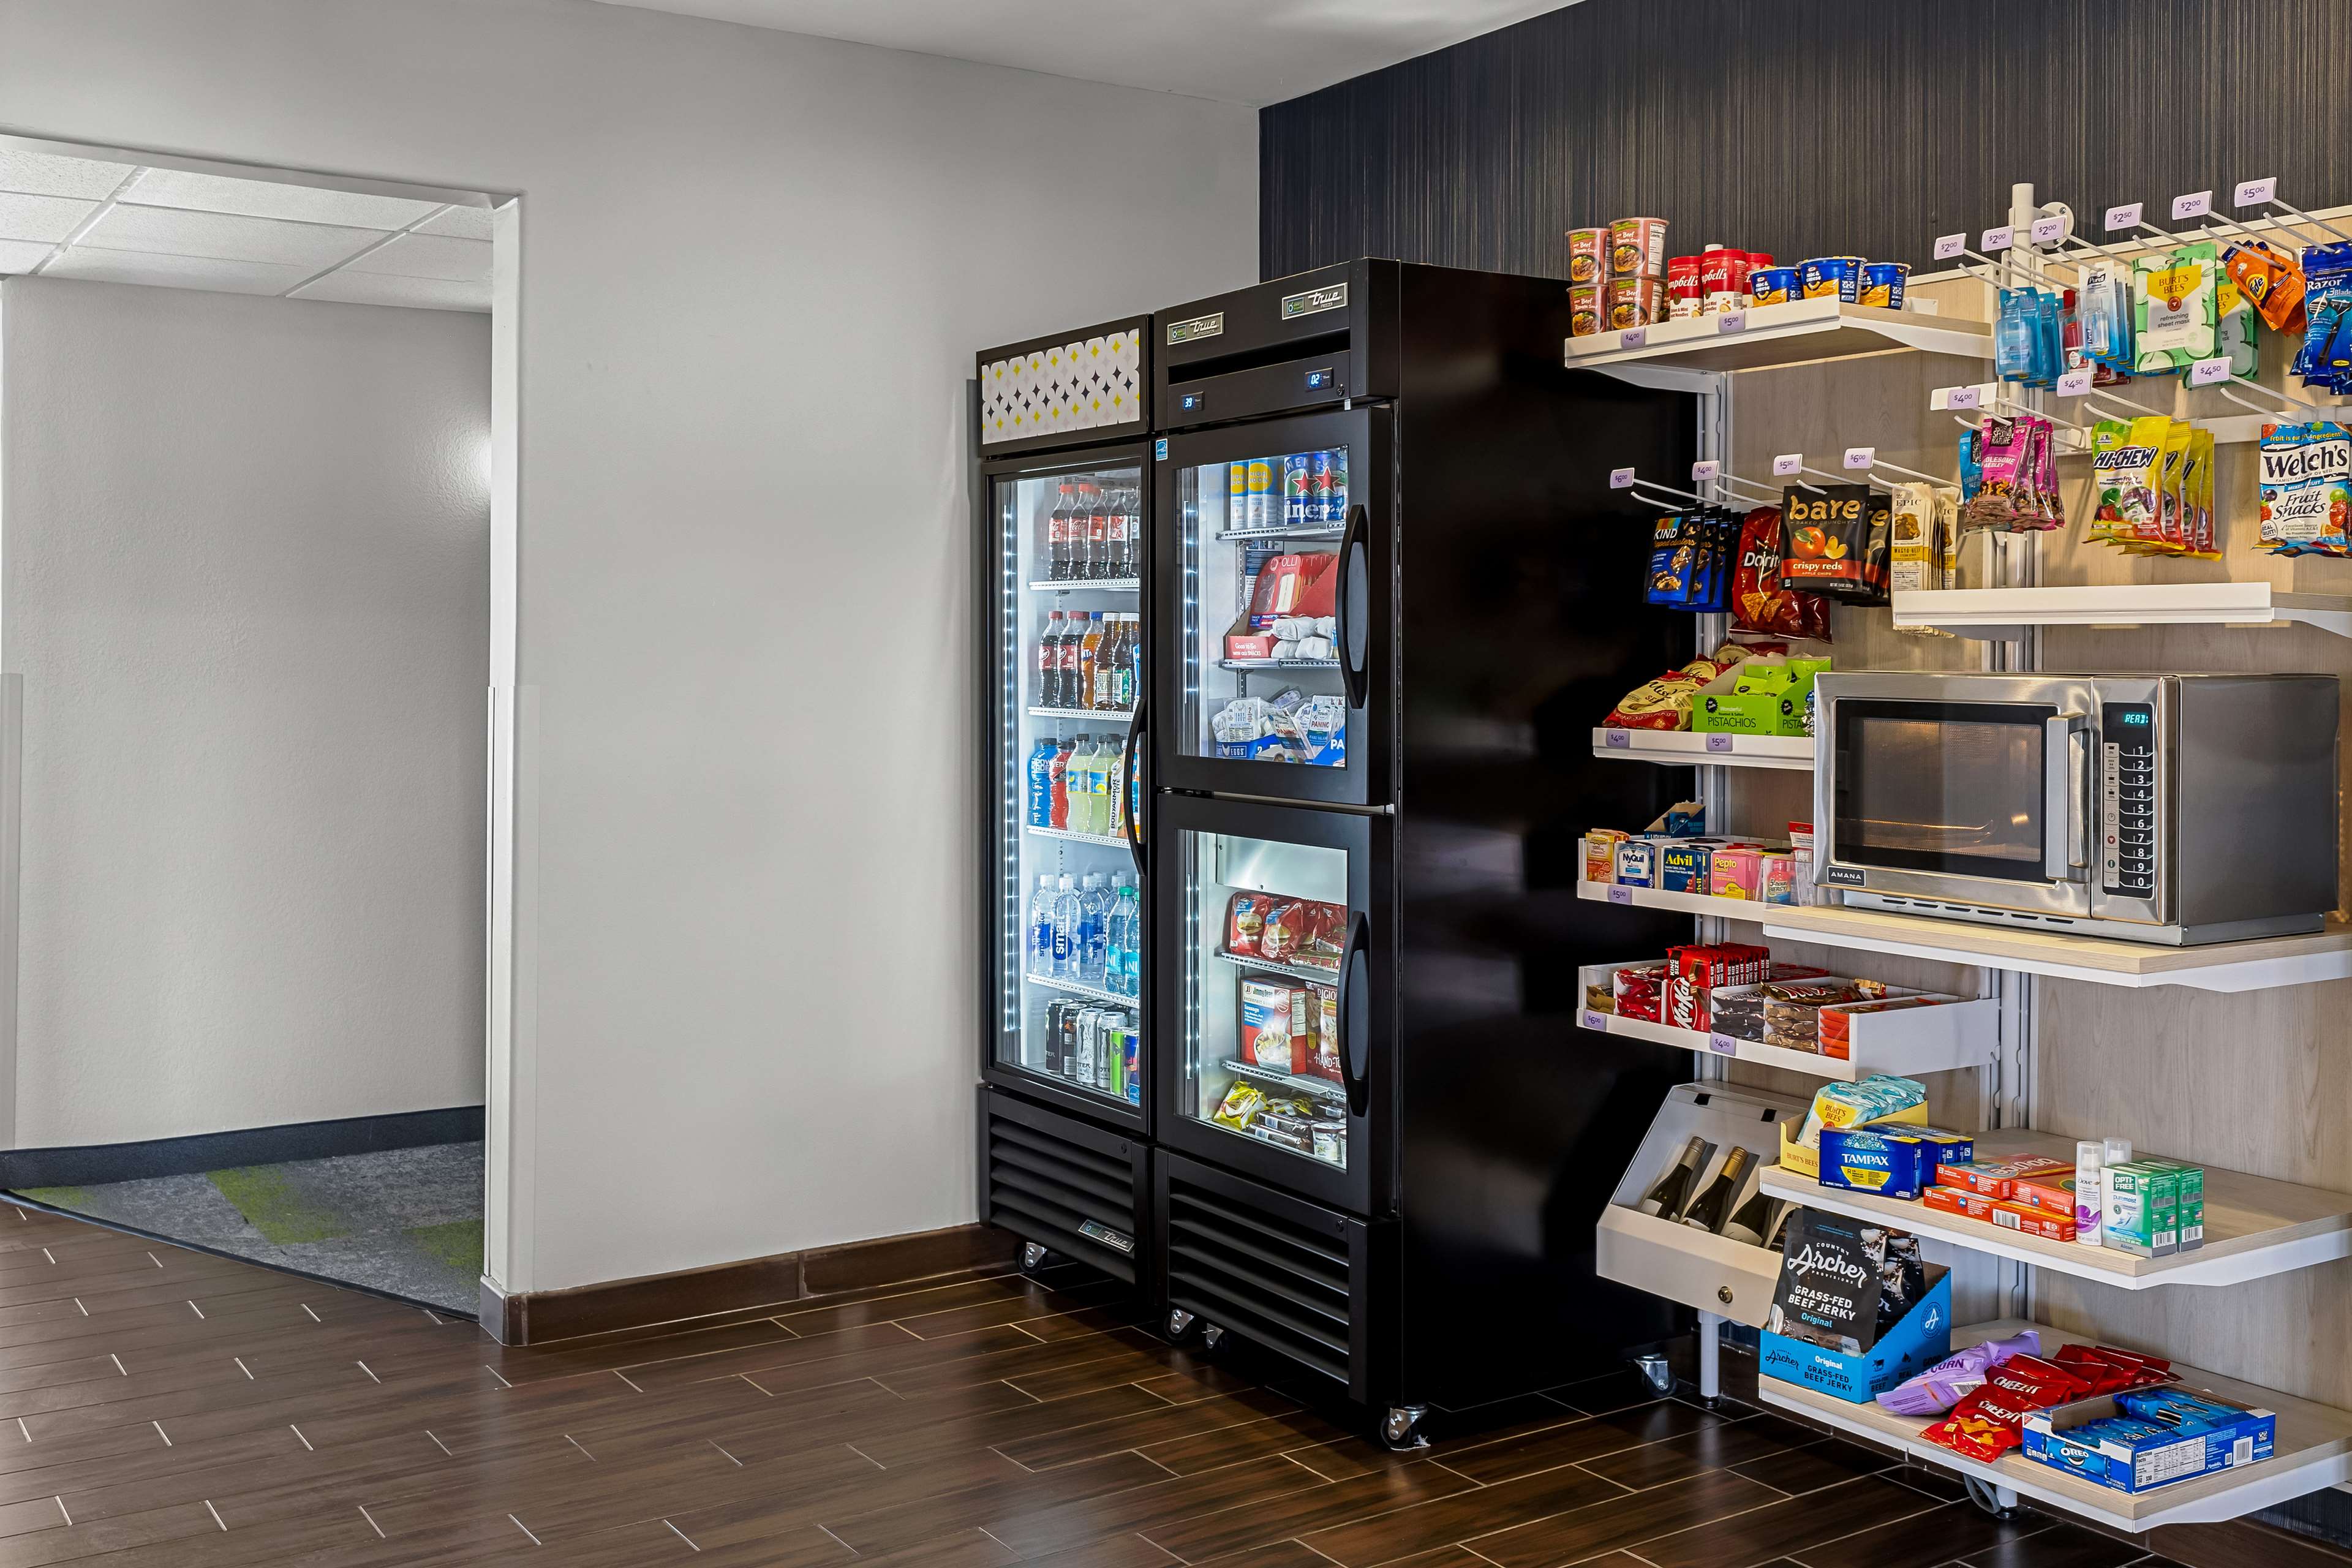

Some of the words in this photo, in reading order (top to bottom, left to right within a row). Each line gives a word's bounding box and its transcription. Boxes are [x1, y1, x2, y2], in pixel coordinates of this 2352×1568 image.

[2159, 274, 2189, 287] BURT'S
[2307, 279, 2342, 292] Razor
[2163, 284, 2185, 294] BEES
[2249, 276, 2266, 299] Tide
[1308, 292, 1343, 306] True
[2160, 312, 2189, 322] refreshing
[1189, 320, 1220, 333] True
[1311, 374, 1320, 385] 02
[1185, 397, 1193, 407] 39
[2094, 447, 2158, 470] HI-CHEW
[2263, 445, 2348, 478] Welch's
[2285, 490, 2321, 507] Fruit
[1790, 494, 1861, 520] bare
[2274, 502, 2326, 519] Snacks
[1654, 529, 1678, 540] KIND
[1282, 557, 1298, 567] OLLI
[1793, 562, 1820, 571] crispy
[1822, 562, 1842, 570] reds
[1708, 717, 1757, 728] PISTACHIOS
[1231, 747, 1245, 756] EGGS
[2138, 746, 2143, 755] 1
[2138, 760, 2144, 769] 2
[2138, 775, 2144, 784] 3
[2138, 790, 2144, 799] 4
[2138, 804, 2144, 813] 5
[2138, 819, 2144, 827] 6
[2138, 834, 2144, 842] 7
[1623, 853, 1644, 863] NyQuil
[2138, 848, 2144, 857] 8
[1666, 854, 1692, 866] Advil
[1715, 858, 1737, 869] Pepto
[2138, 862, 2144, 872] 9
[2138, 877, 2144, 886] 0
[1056, 915, 1065, 954] smart
[1825, 1104, 1846, 1117] BURT'S
[1825, 1112, 1841, 1122] BEES
[1787, 1152, 1804, 1164] BURT'S
[1805, 1158, 1818, 1167] BEES
[1842, 1153, 1889, 1166] TAMPAX
[1991, 1158, 2061, 1175] bounce
[2113, 1195, 2136, 1204] puremoist
[1104, 1231, 1128, 1248] True
[1816, 1242, 1850, 1256] COUNTRY
[1787, 1244, 1867, 1289] Archer
[1811, 1270, 1853, 1284] PROVISIONS
[1795, 1285, 1852, 1309] GRASS-FED
[1788, 1294, 1816, 1309] BEEF
[1817, 1303, 1856, 1321] JERKY
[1801, 1312, 1833, 1328] Original
[1765, 1349, 1800, 1371] Archer
[1815, 1355, 1843, 1370] Original
[1807, 1365, 1849, 1383] GRASS-FED
[1804, 1371, 1825, 1385] BEEF
[1826, 1379, 1853, 1392] JERKY
[1871, 1382, 1887, 1392] BEEF
[2060, 1447, 2089, 1457] OREO
